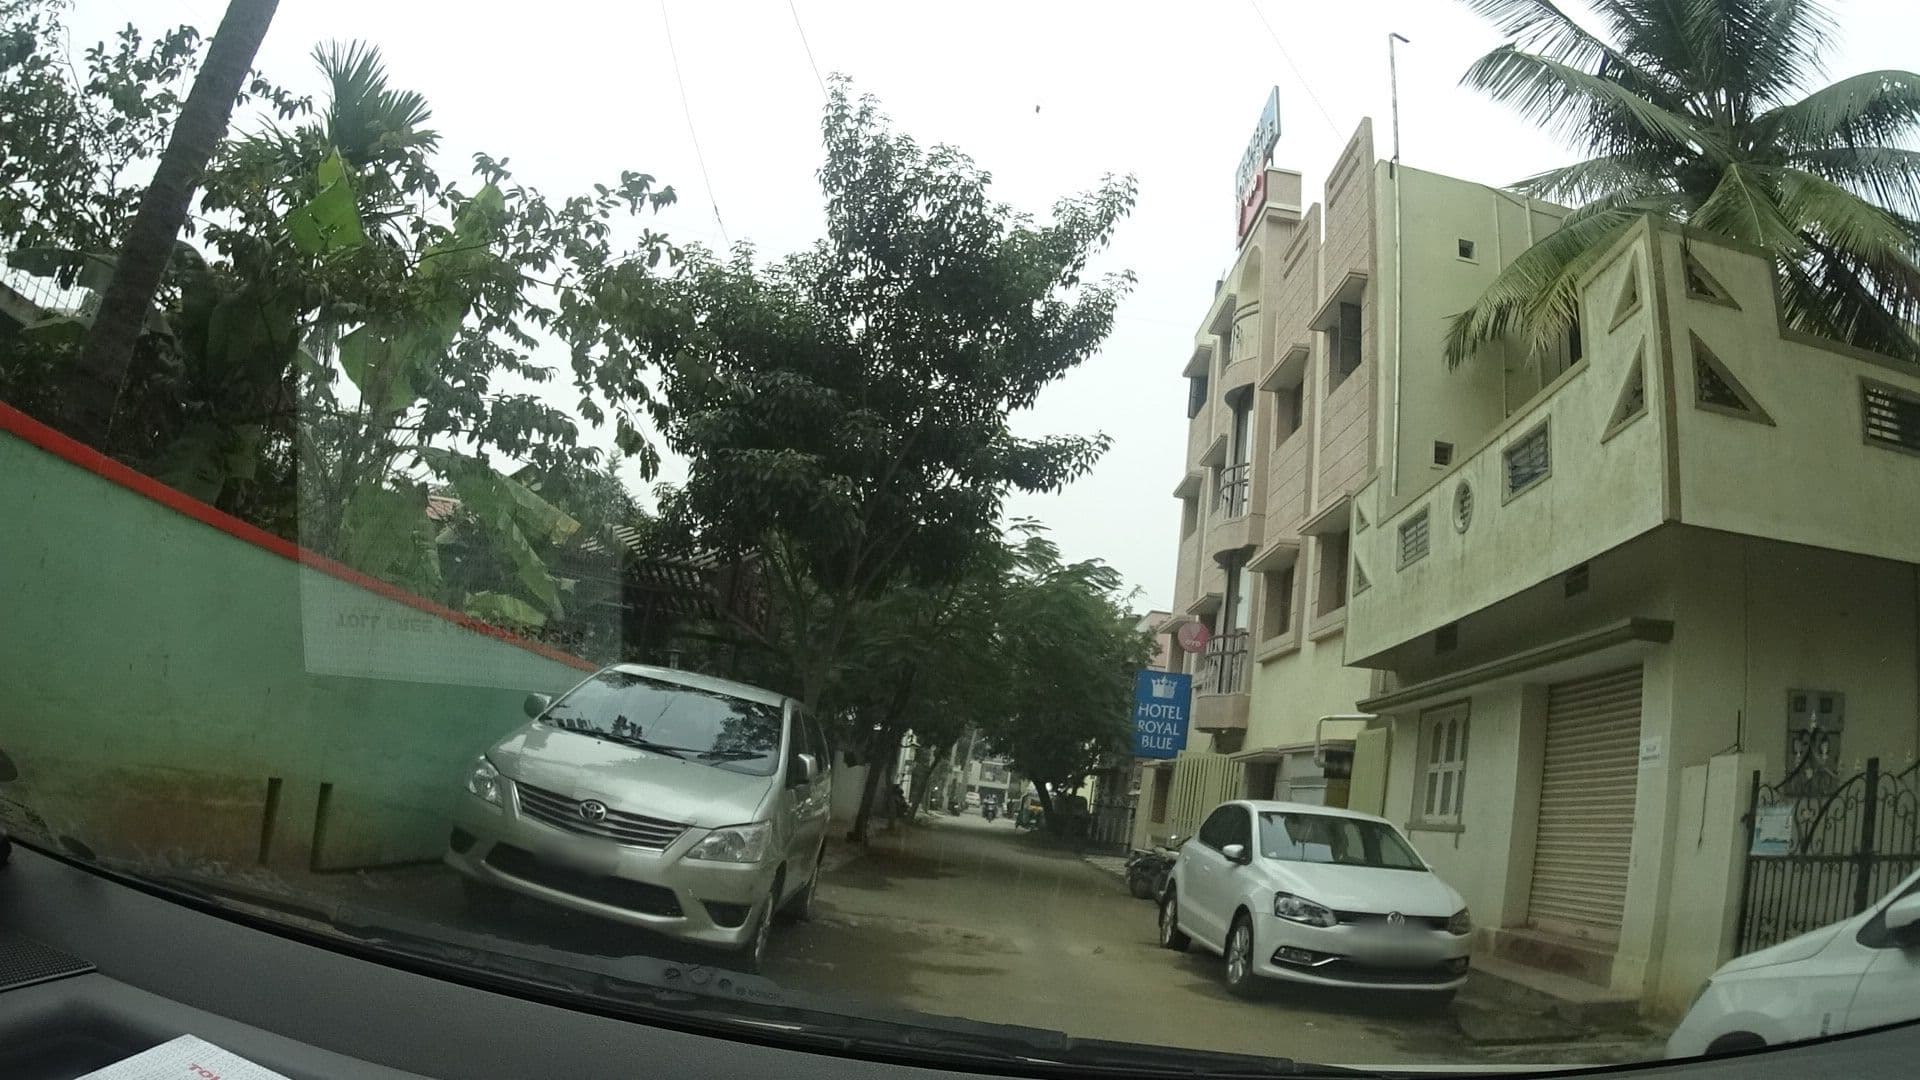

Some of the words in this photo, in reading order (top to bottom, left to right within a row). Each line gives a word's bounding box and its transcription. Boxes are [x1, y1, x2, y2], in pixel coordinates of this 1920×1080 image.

[1138, 702, 1183, 720] HOTEL
[1138, 720, 1180, 736] ROYAL
[1141, 735, 1173, 750] BLUE
